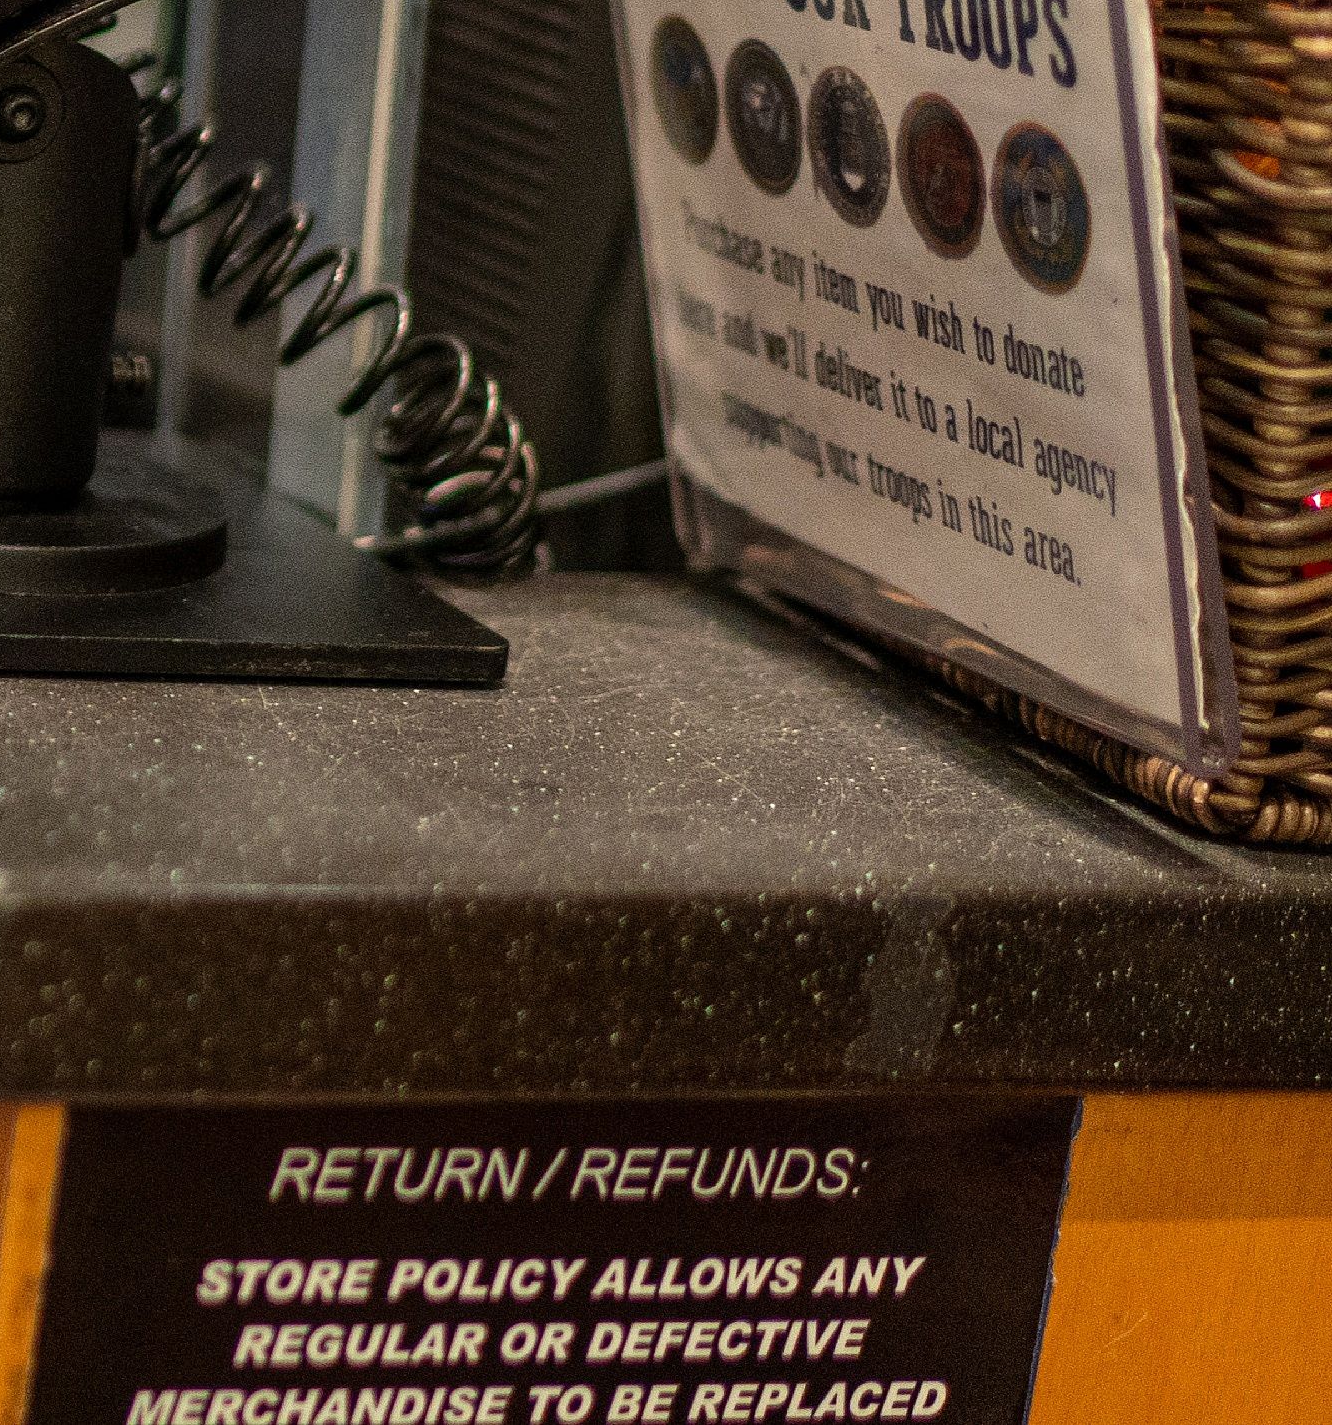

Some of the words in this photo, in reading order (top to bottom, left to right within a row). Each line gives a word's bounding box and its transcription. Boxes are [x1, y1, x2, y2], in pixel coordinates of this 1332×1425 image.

[770, 245, 806, 302] any
[812, 249, 860, 314] item
[865, 282, 905, 333] you
[911, 293, 966, 354] wish
[972, 316, 995, 365] to
[1003, 323, 1085, 397] donate
[814, 341, 884, 412] deliver
[890, 370, 912, 422] it
[914, 386, 937, 433] to
[944, 404, 959, 443] a
[966, 397, 1025, 469] local
[1033, 437, 1117, 517] agency
[866, 451, 933, 525] troops
[937, 479, 963, 533] in
[968, 495, 1016, 557] this
[1023, 526, 1082, 587] area.
[267, 1146, 532, 1204] RETURN
[569, 1147, 871, 1202] REFUNDS:
[196, 1257, 380, 1306] STORE
[386, 1257, 588, 1303] POLICY
[590, 1255, 805, 1301] ALLOWS
[811, 1254, 927, 1299] ANY
[232, 1321, 490, 1370] REGULAR
[498, 1320, 577, 1365] OR
[585, 1318, 871, 1364] DEFECTIVE
[125, 1385, 516, 1425] MERCHANDISE
[528, 1384, 596, 1425] TO
[605, 1383, 682, 1425] BE
[687, 1380, 951, 1425] REPLACED
